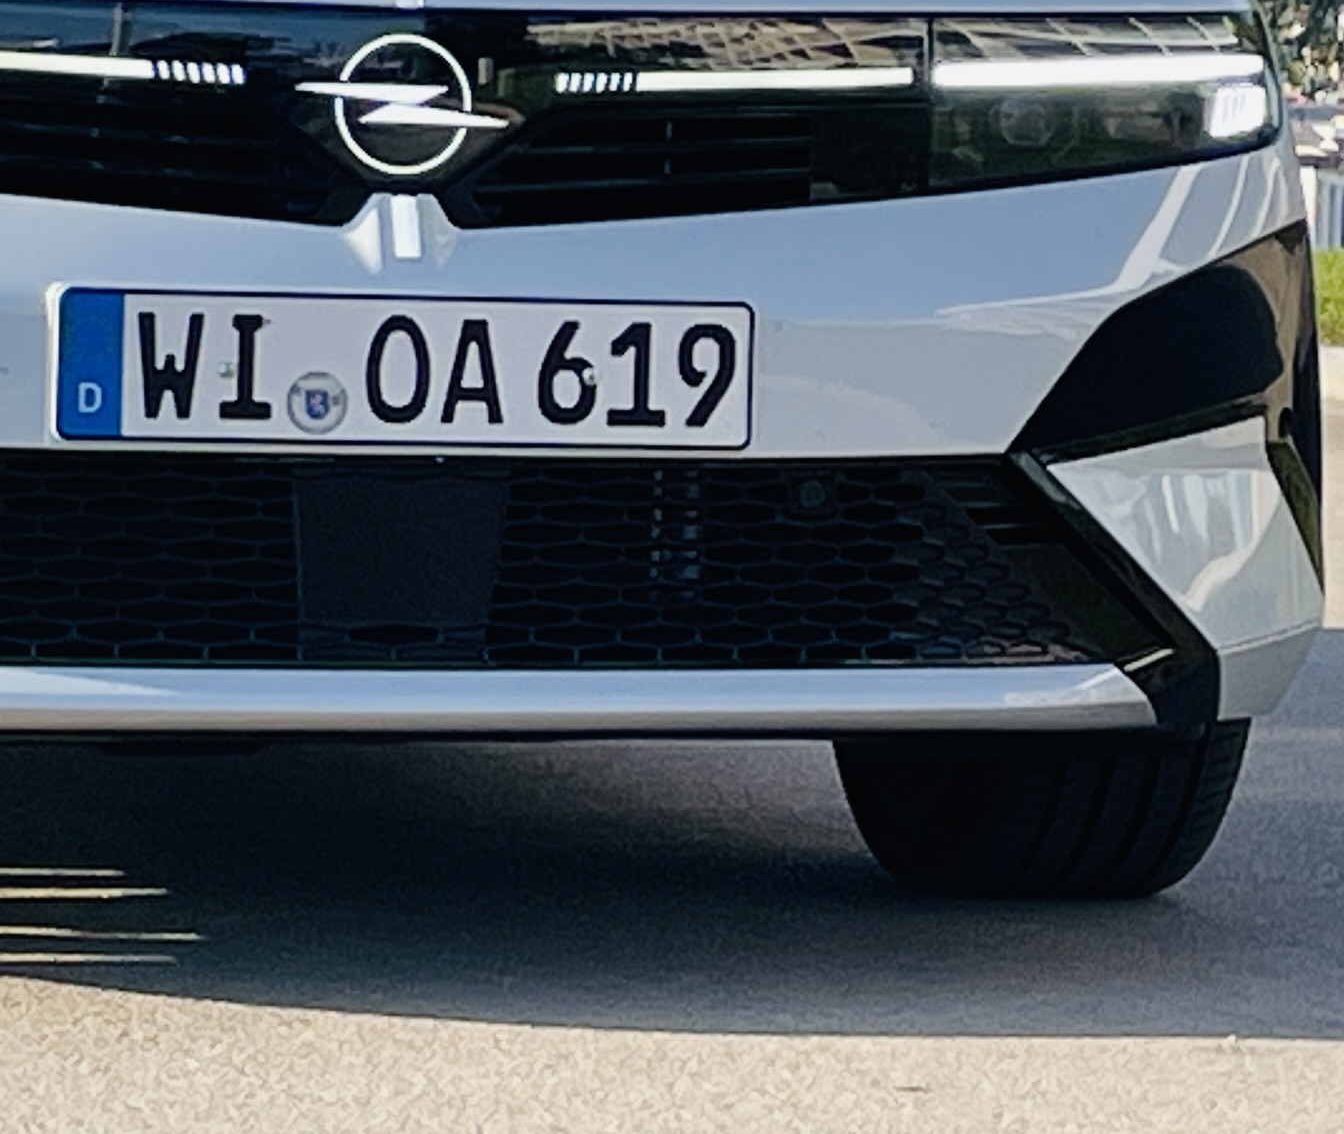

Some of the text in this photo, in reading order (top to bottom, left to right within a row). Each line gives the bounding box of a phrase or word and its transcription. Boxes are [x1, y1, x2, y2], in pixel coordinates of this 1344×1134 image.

[77, 382, 101, 413] D
[137, 311, 737, 428] WI OA 619
